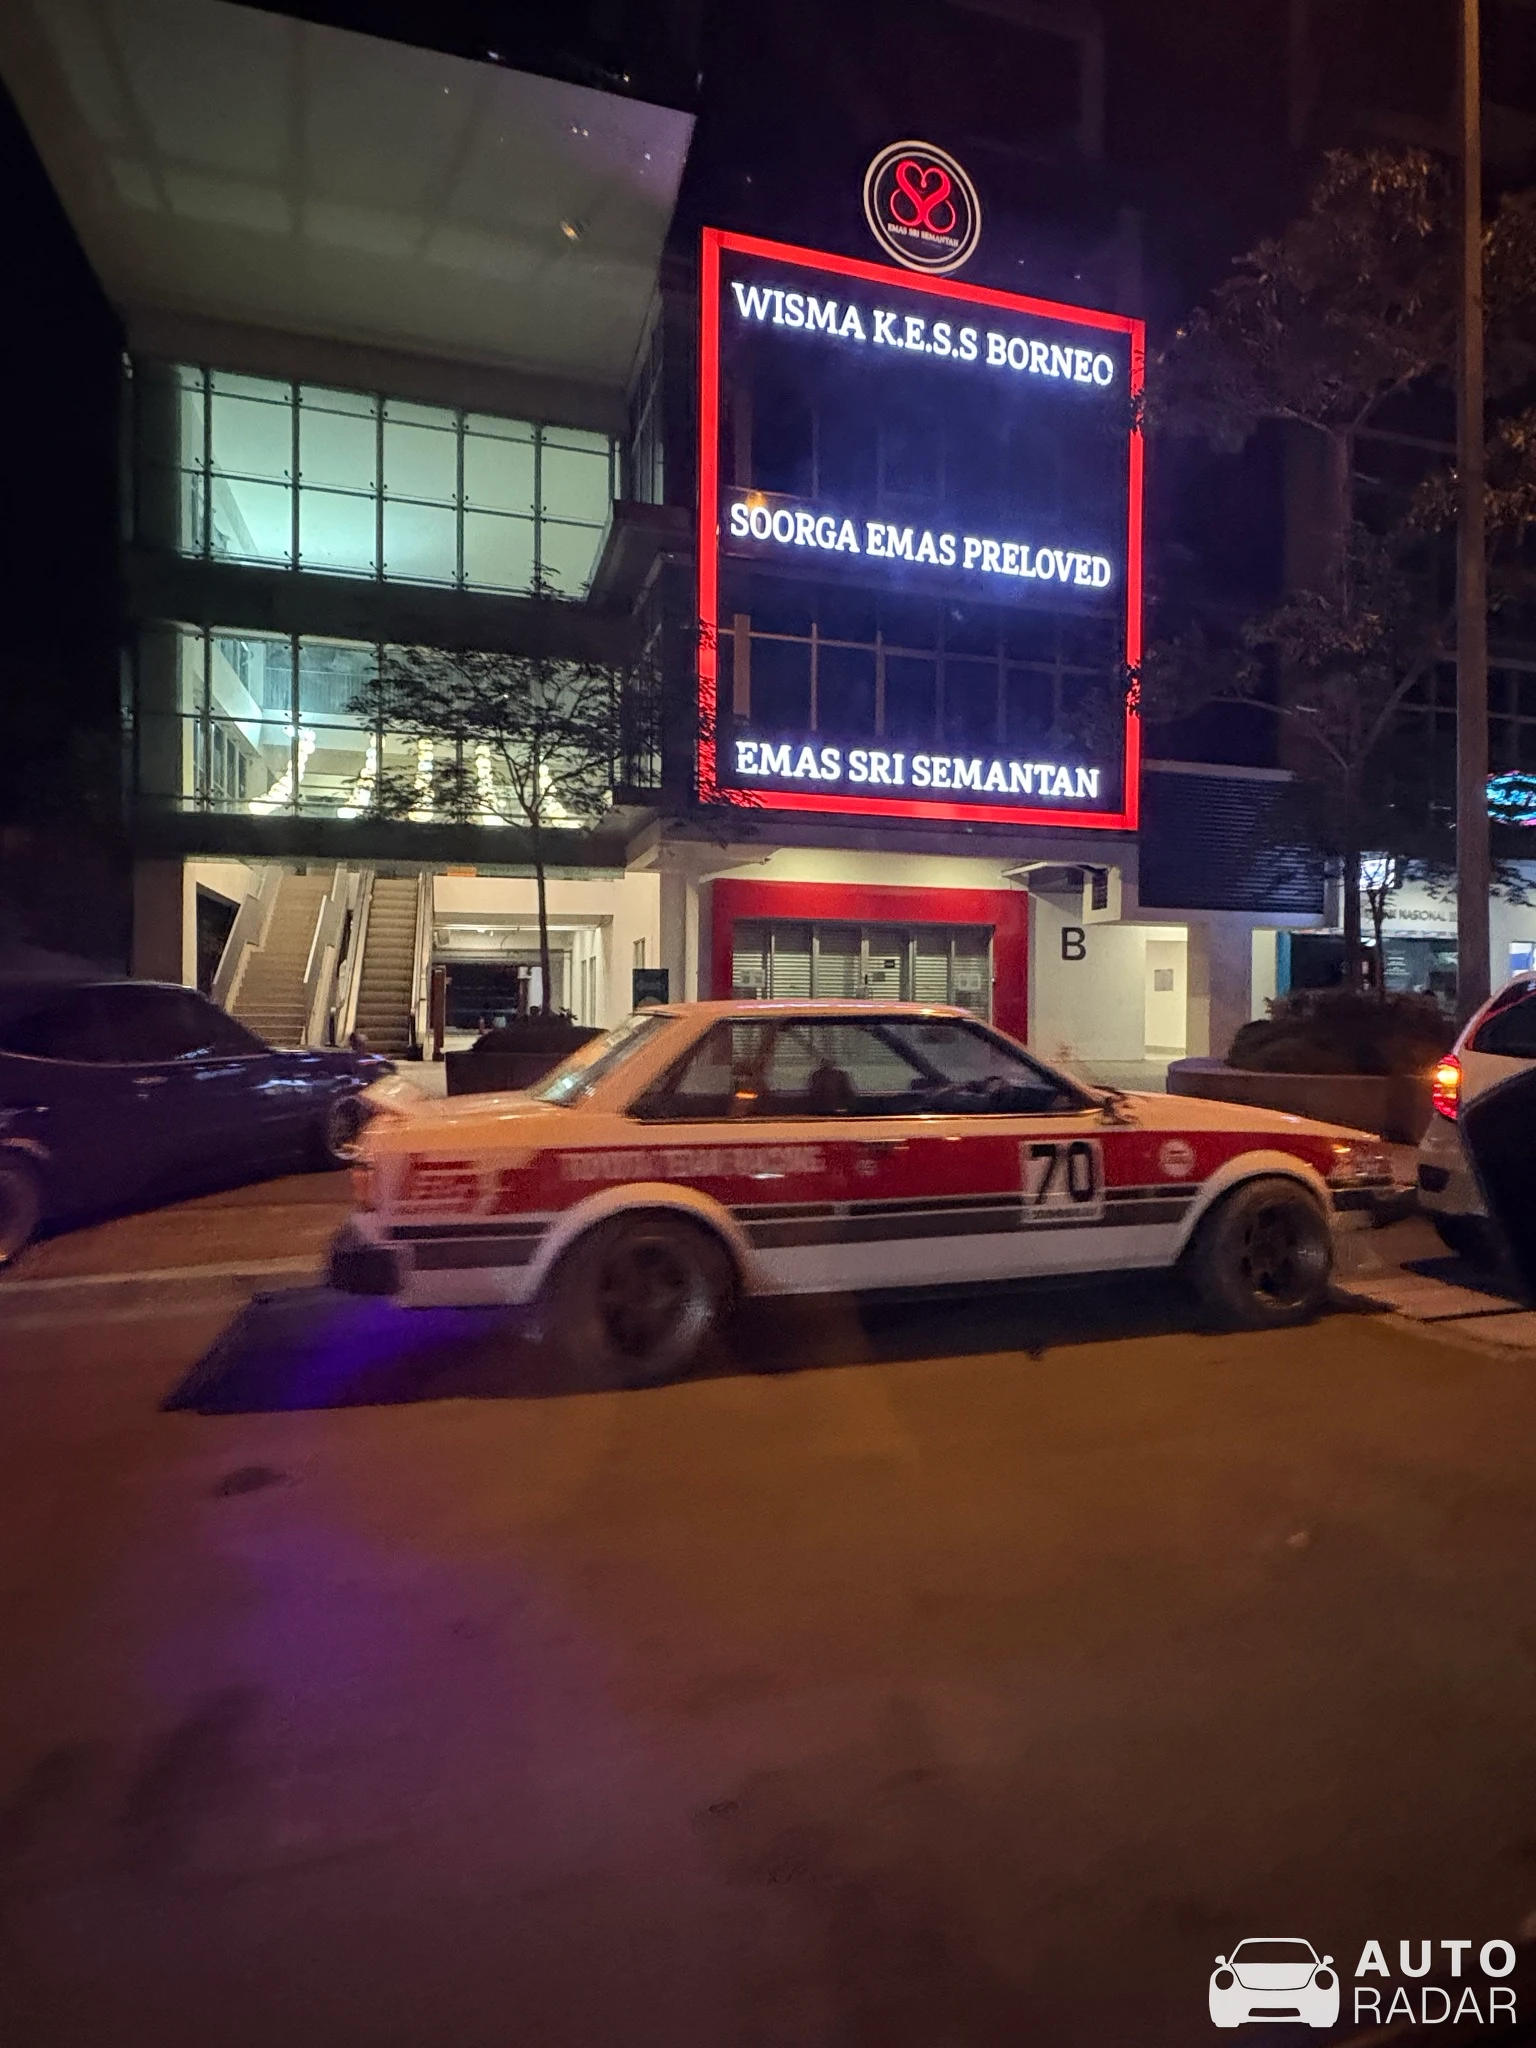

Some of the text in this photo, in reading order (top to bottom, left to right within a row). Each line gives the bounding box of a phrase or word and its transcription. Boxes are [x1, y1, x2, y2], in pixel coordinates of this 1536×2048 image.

[888, 223, 907, 235] EMAS
[732, 282, 1114, 386] WISMA K.E.S.S BORNEO
[730, 504, 1111, 588] SOORGA EMAS PRELOVED
[735, 741, 1100, 799] EMAS SRI SEMANTAN
[1061, 926, 1087, 961] B
[1031, 1141, 1095, 1205] 70
